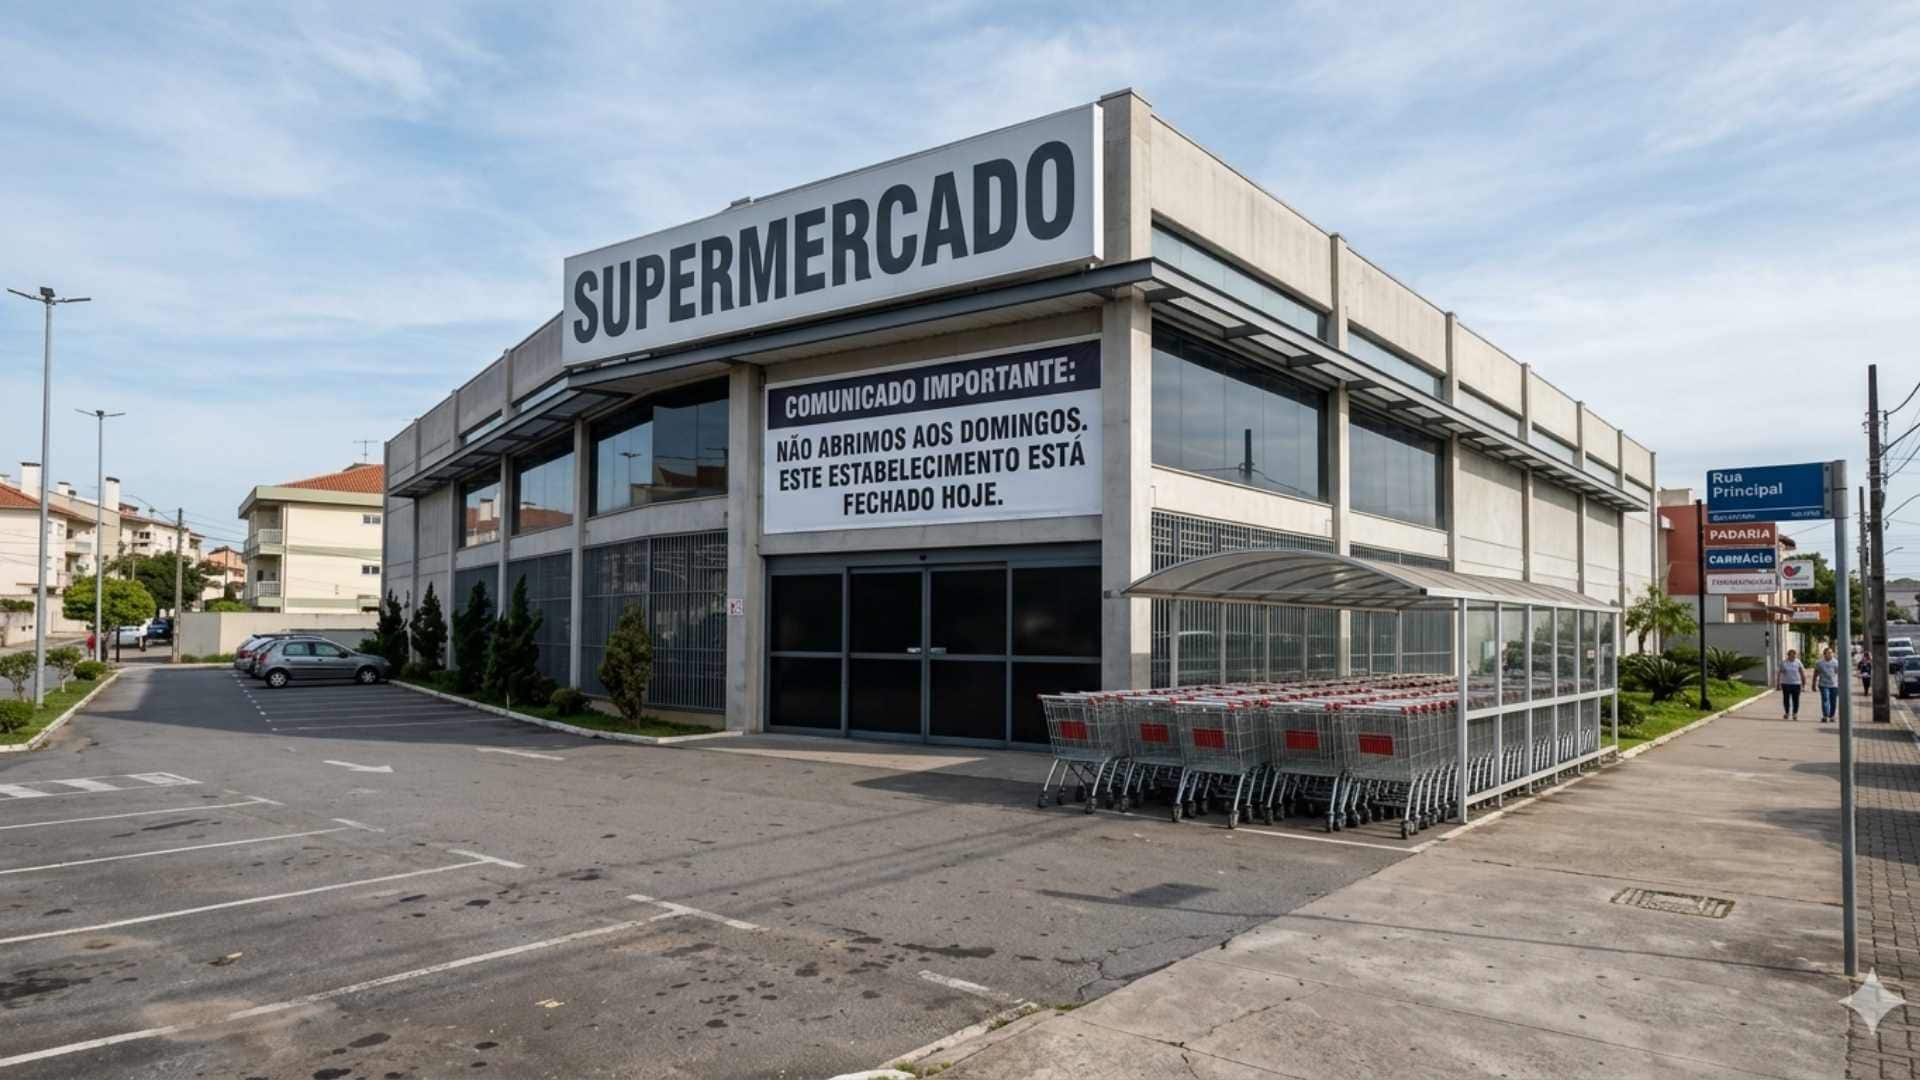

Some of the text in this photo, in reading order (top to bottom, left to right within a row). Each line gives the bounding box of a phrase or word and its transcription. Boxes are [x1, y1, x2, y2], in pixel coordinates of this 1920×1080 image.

[573, 140, 1076, 344] SUPERMERCADO
[785, 356, 1076, 419] COMUNICADO IMPORTANTE:
[777, 407, 1088, 462] NÃO ABRIMOS AOS DOMINGOS.
[779, 435, 1086, 491] ESTE ESTABELECIMENTO ESTÁ
[1712, 472, 1743, 484] Rua
[843, 482, 1004, 516] FECHADO HOJE.
[1713, 482, 1783, 498] Principal
[1710, 529, 1770, 540] PADARIA
